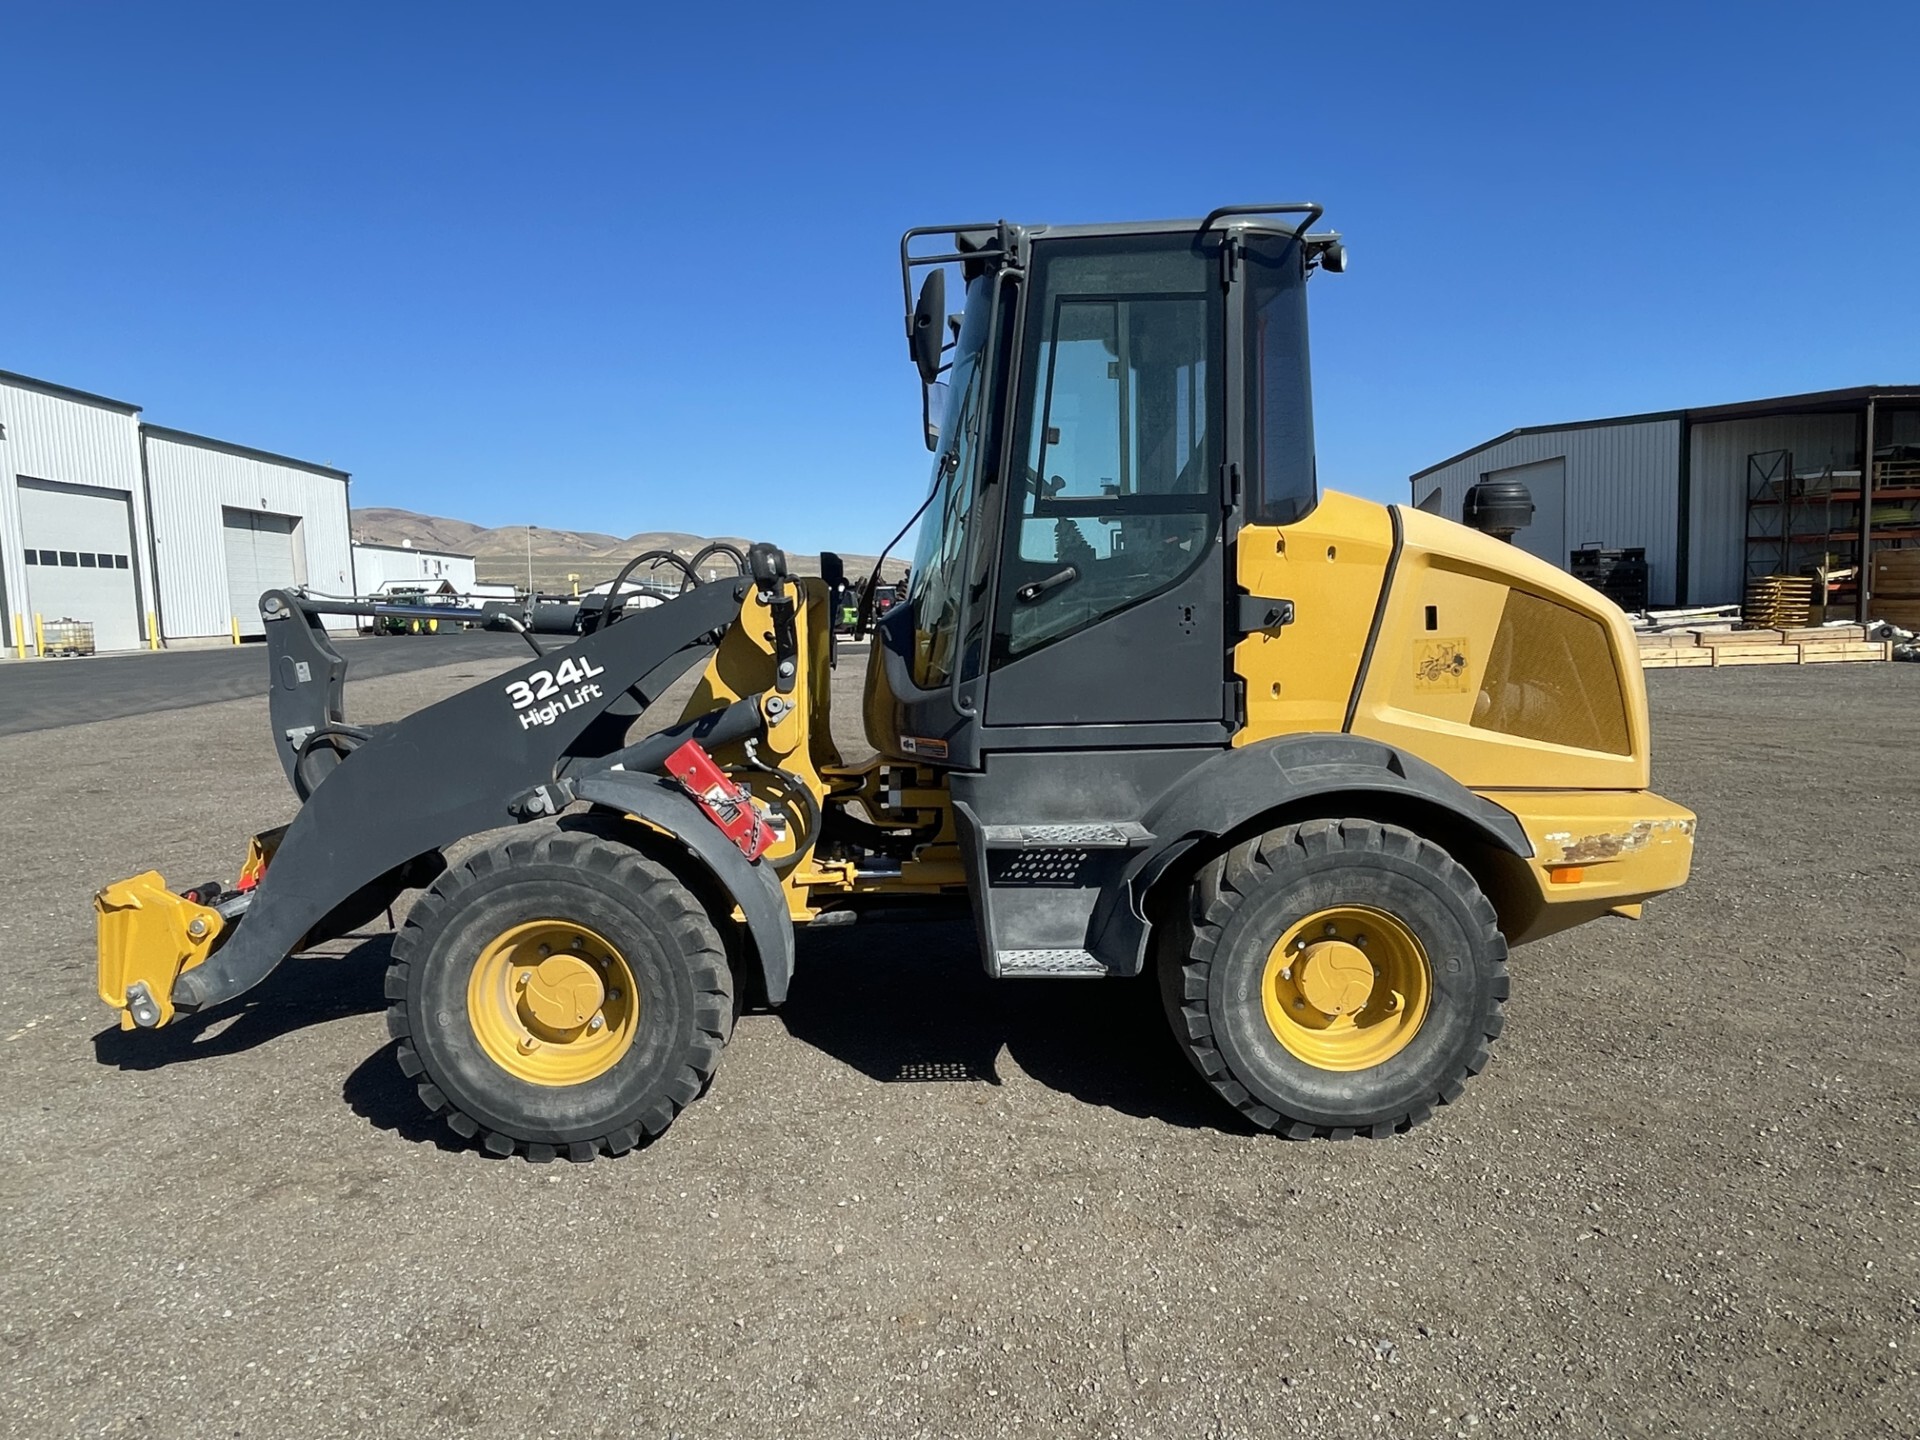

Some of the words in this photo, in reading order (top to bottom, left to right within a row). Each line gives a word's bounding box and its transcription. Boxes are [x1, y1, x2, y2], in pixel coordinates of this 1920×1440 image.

[505, 656, 605, 710] 324L
[519, 701, 566, 730] High
[563, 684, 603, 710] Lift
